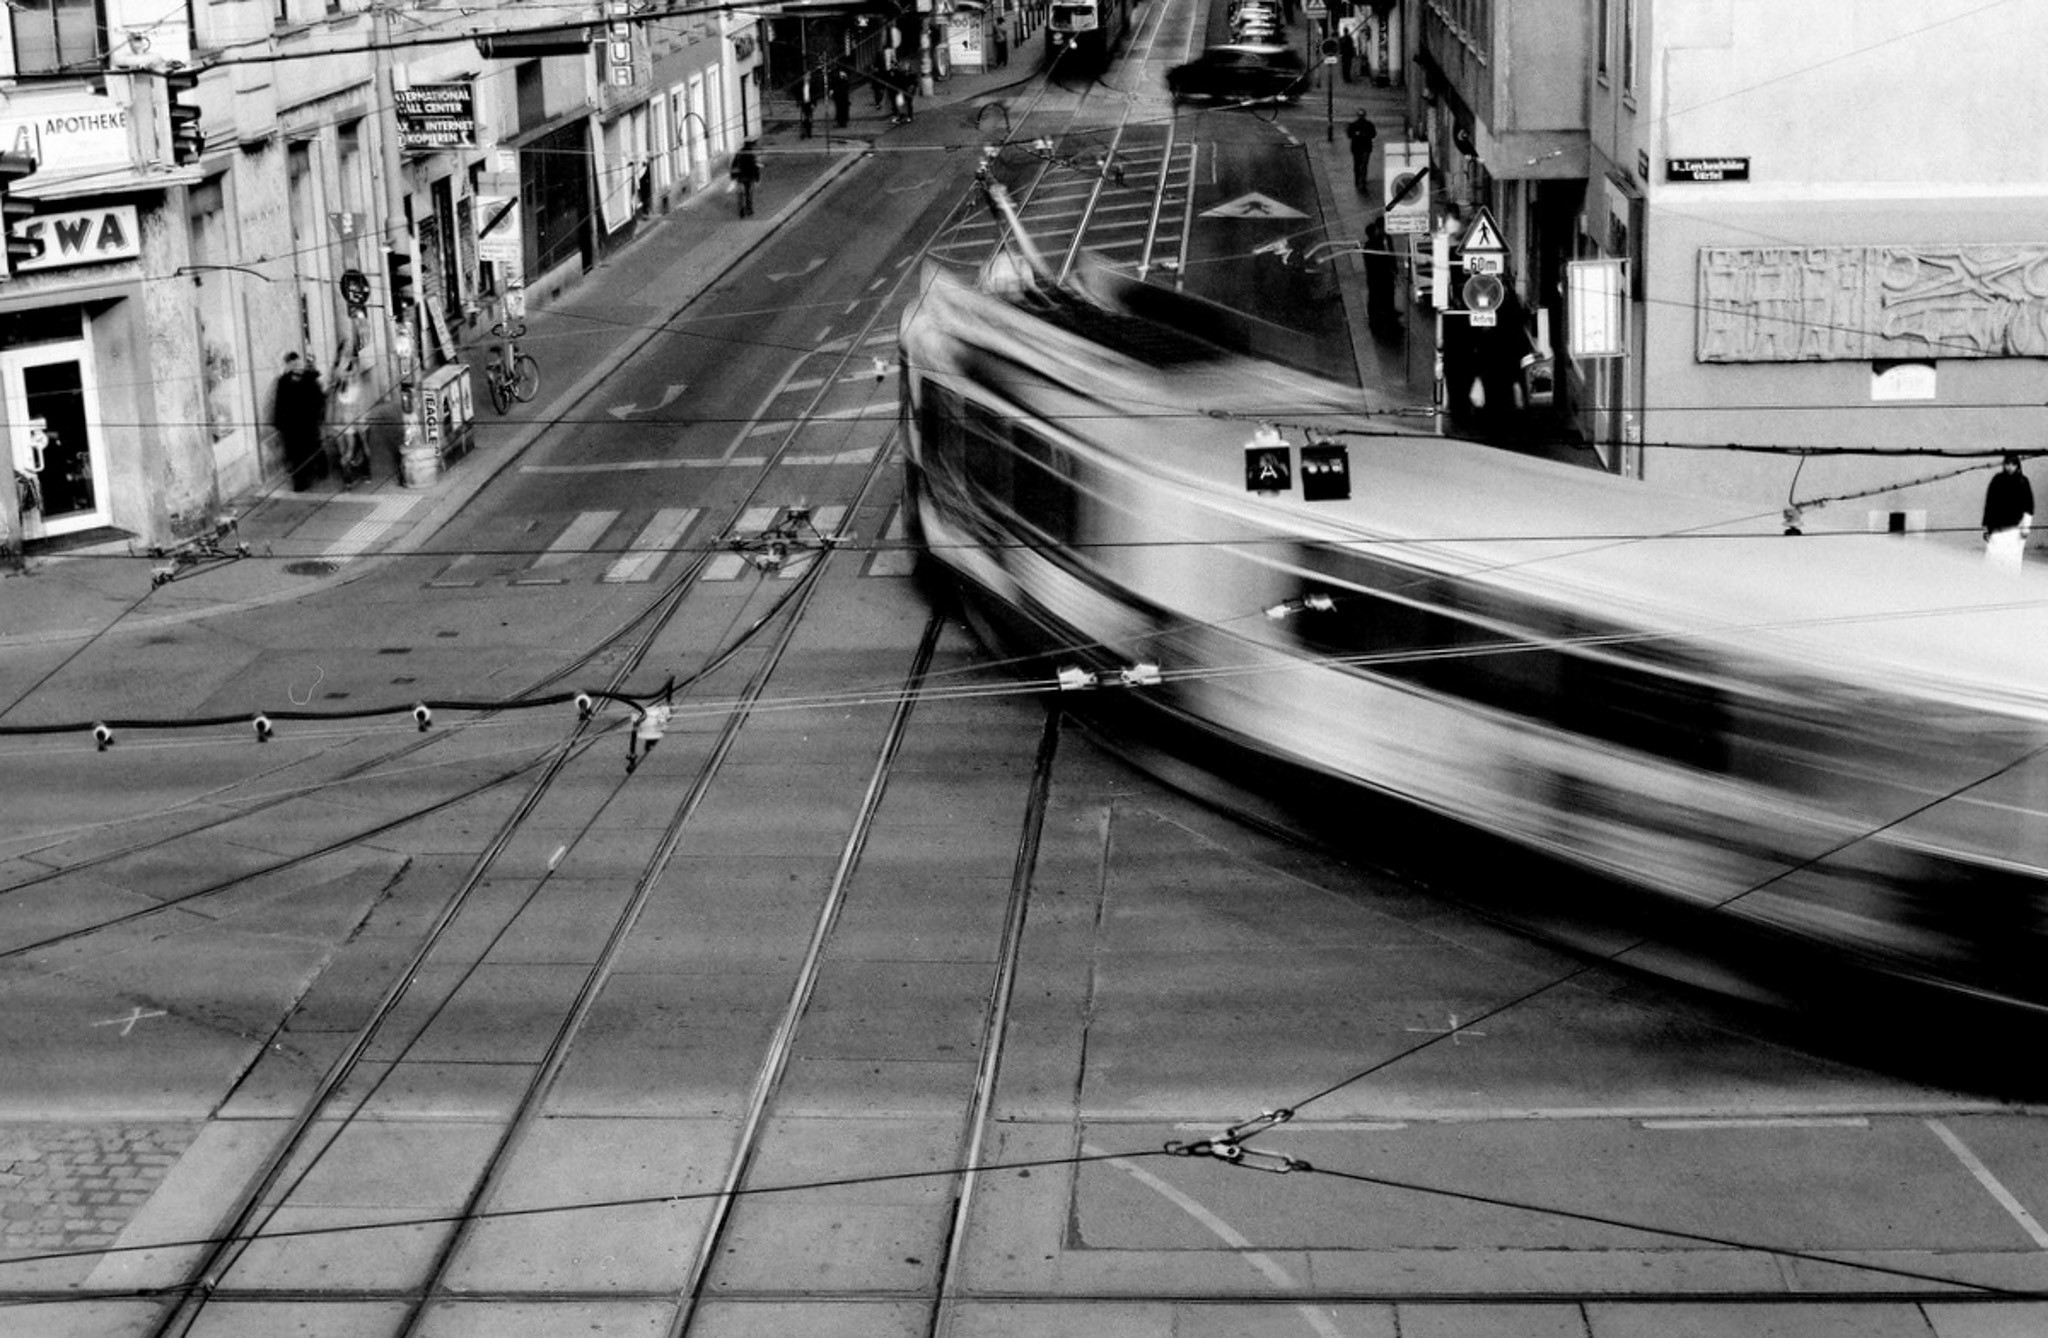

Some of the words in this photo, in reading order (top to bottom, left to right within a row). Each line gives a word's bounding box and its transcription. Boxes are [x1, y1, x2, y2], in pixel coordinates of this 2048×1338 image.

[394, 90, 470, 101] NTERNATIONAL
[425, 103, 462, 113] CENTER
[45, 112, 127, 136] APOTHEKE
[397, 122, 409, 131] AX
[425, 121, 473, 131] INTERNET
[407, 133, 458, 143] KOPIEREN
